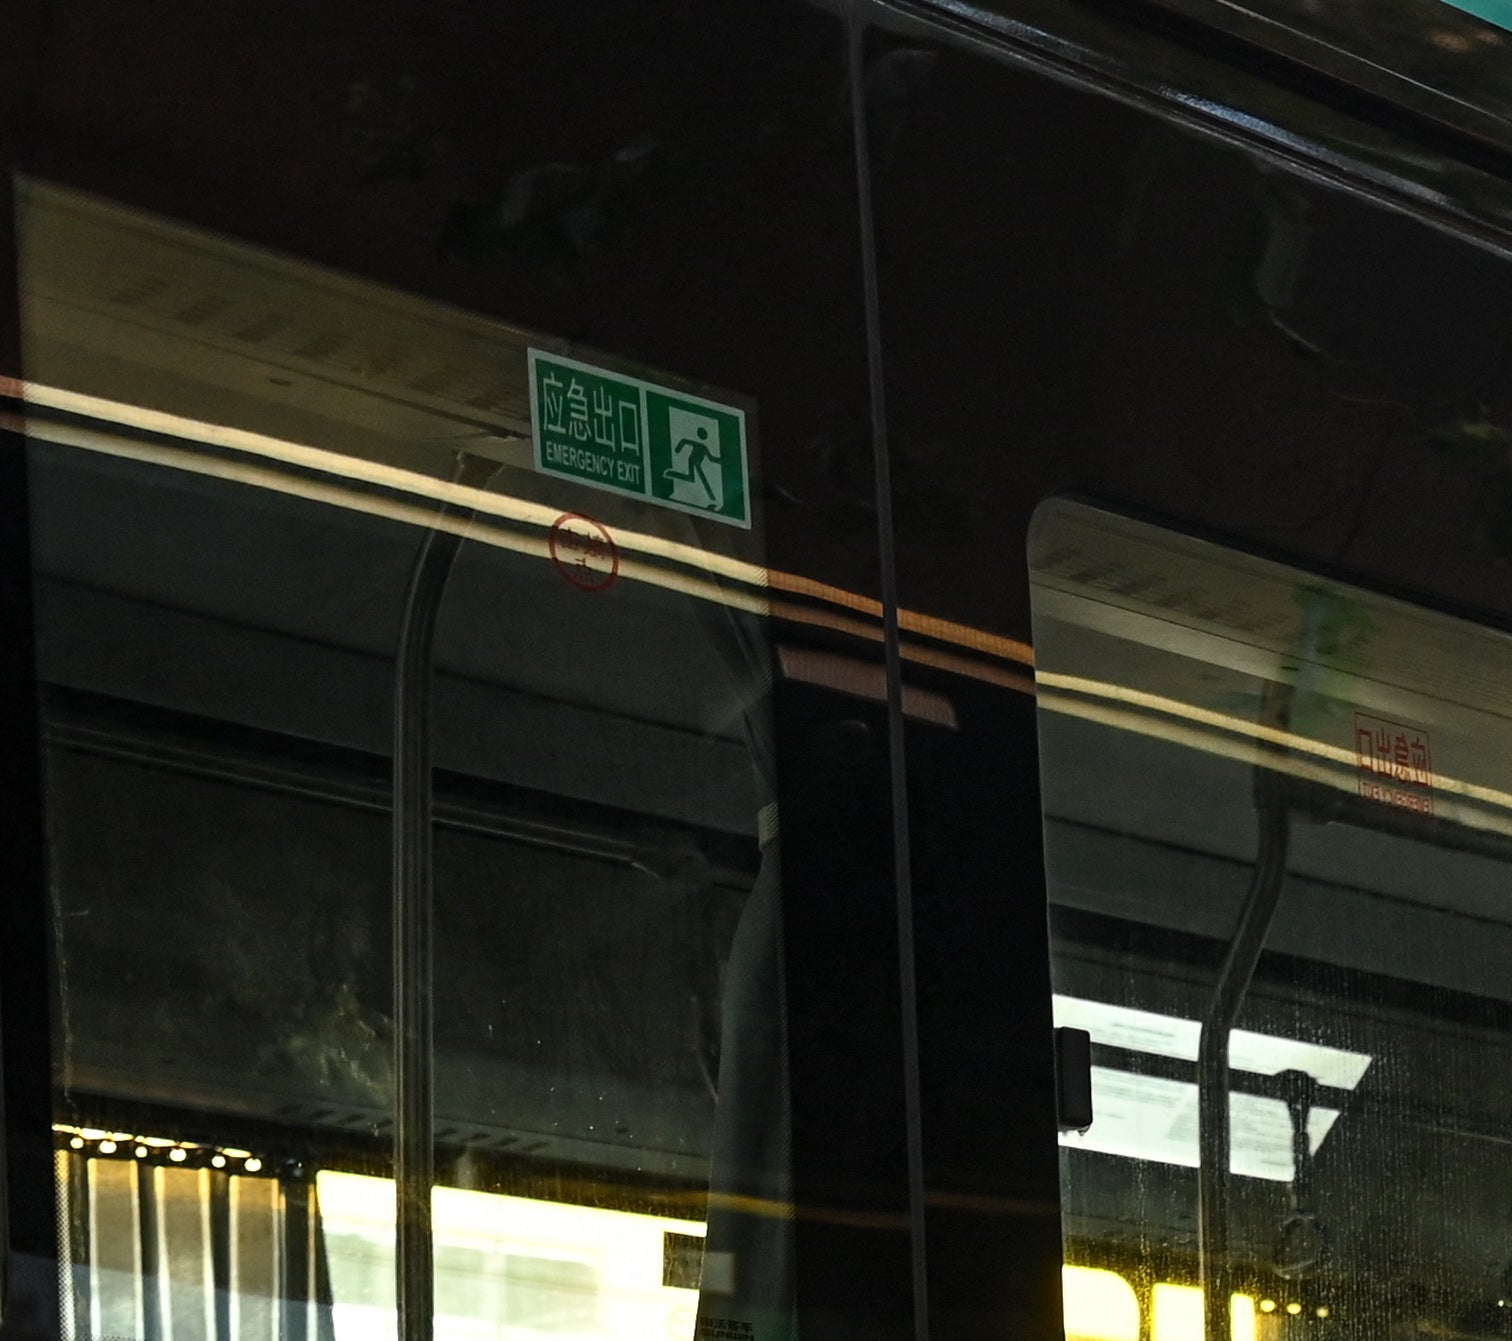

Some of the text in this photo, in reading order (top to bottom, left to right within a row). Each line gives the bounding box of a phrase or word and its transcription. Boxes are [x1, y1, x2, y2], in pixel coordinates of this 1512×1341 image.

[542, 371, 640, 457] 应急出口
[545, 440, 641, 487] EMERGENCY EXIT
